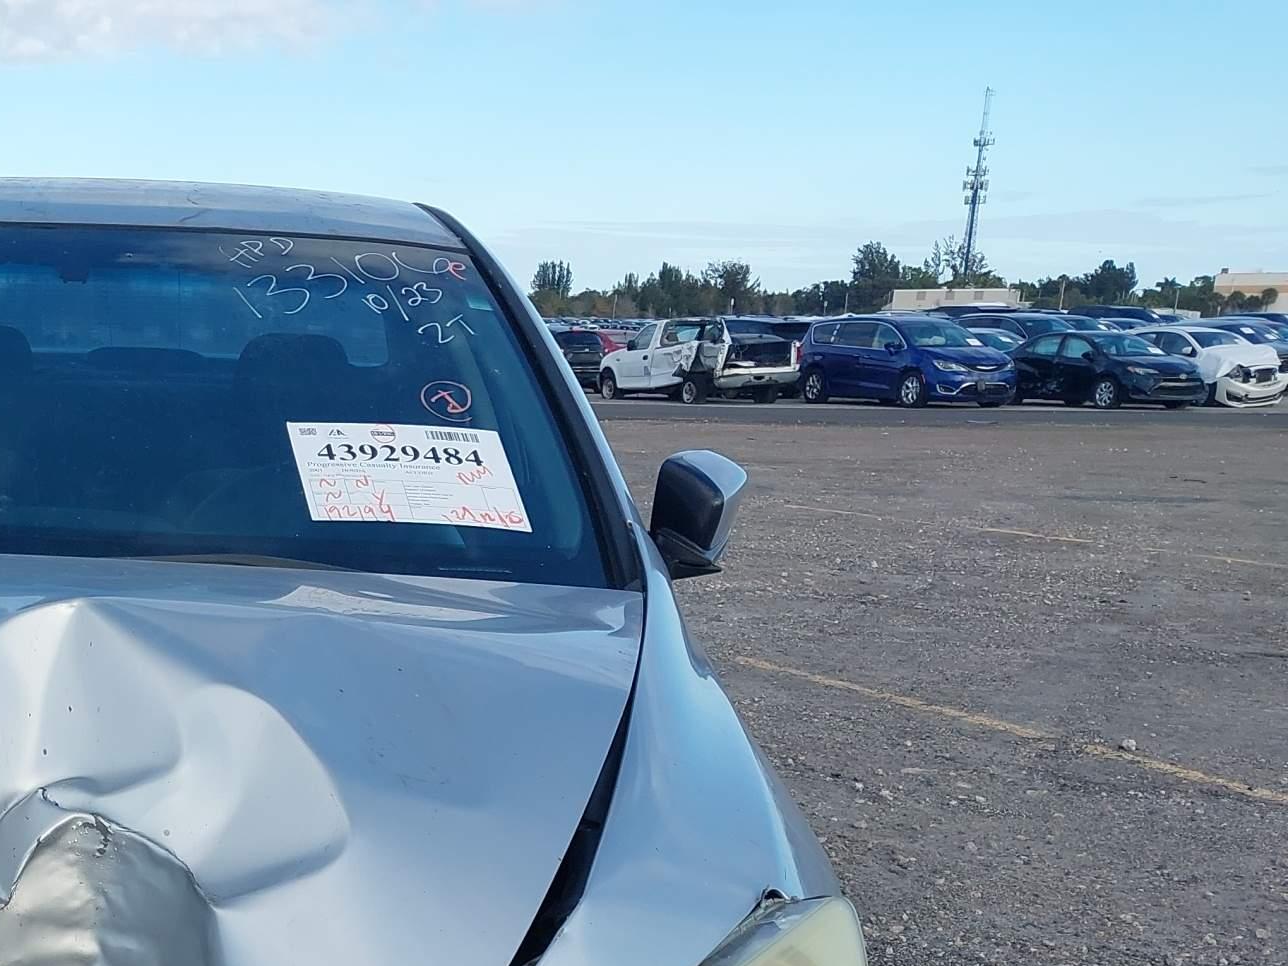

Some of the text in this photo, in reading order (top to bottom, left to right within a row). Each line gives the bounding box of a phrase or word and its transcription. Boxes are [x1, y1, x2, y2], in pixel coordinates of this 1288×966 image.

[362, 281, 443, 322] 10/23
[307, 461, 441, 471] Progressive Casualty Insurance
[317, 443, 484, 467] 43929484
